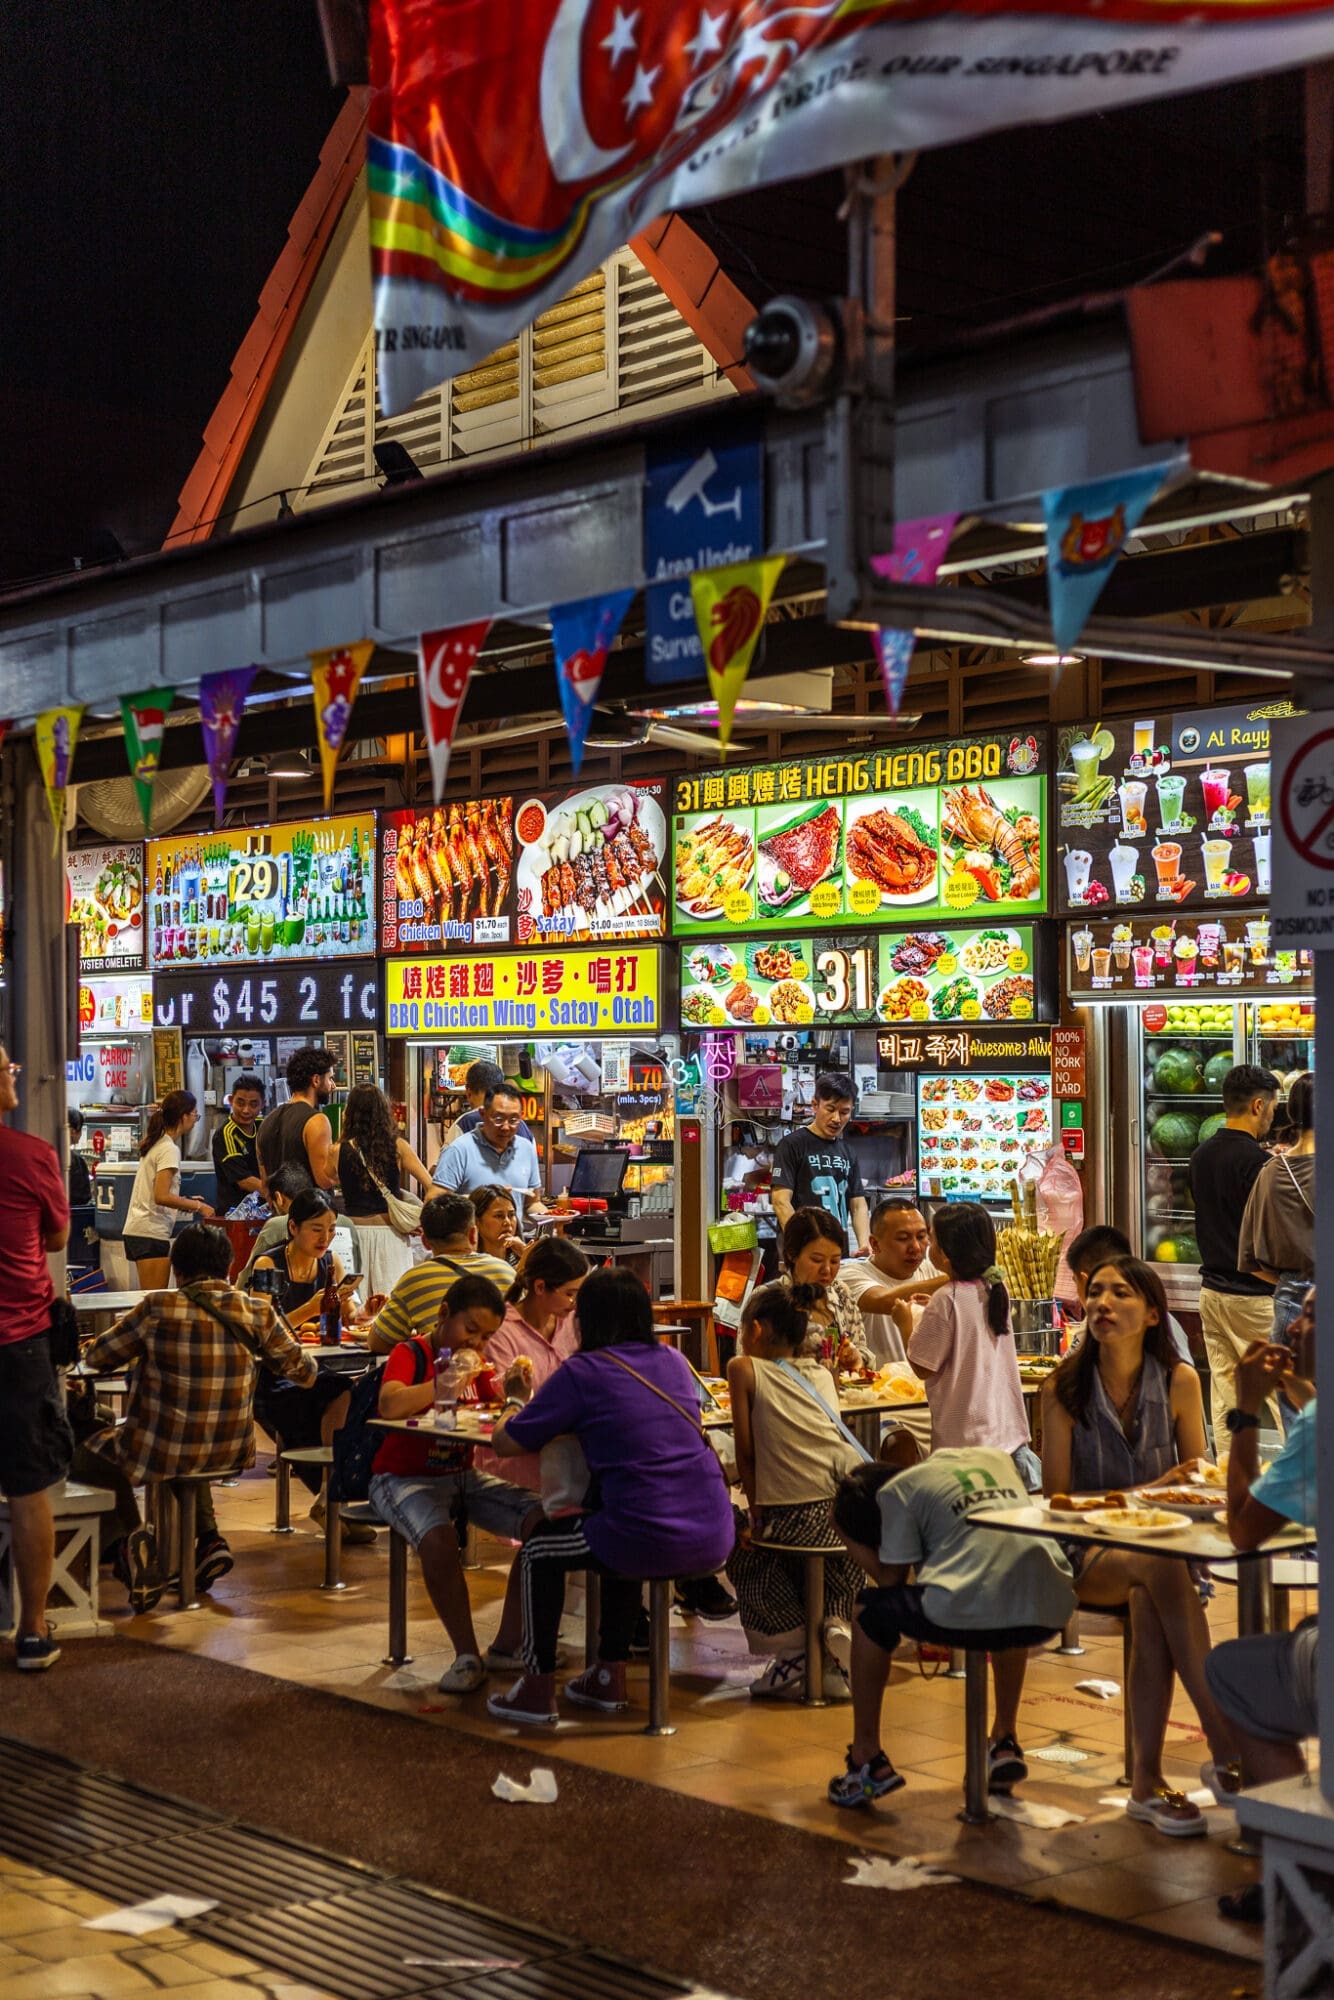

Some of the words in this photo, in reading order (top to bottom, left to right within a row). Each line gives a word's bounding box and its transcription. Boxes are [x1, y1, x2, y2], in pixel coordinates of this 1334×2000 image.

[655, 556, 695, 579] Area
[1206, 729, 1226, 748] Al
[677, 780, 700, 811] 31
[806, 760, 869, 797] HENG
[874, 751, 941, 788] HENG
[947, 743, 1000, 781] BBQ
[129, 847, 142, 865] 28
[235, 861, 273, 901] 29
[1306, 887, 1326, 907] NO
[399, 900, 423, 918] BBQ
[399, 923, 441, 941] Chicken
[442, 922, 472, 942] Wing
[475, 919, 497, 930] $1.70
[536, 914, 576, 936] Satay
[590, 919, 612, 930] $1.00
[105, 956, 142, 969] OMELETTE
[816, 948, 873, 1012] 31
[212, 977, 279, 1030] $45
[299, 976, 318, 1020] 2
[389, 1002, 419, 1031] BBQ
[423, 1001, 489, 1028] Chicken
[492, 999, 536, 1029] Wing
[549, 997, 599, 1027] Satay
[612, 995, 655, 1024] Otah
[1055, 1031, 1080, 1043] 100%
[99, 1047, 133, 1067] CARROT
[1055, 1045, 1070, 1057] NO
[1055, 1056, 1081, 1068] PORK
[104, 1070, 128, 1088] CAKE
[1055, 1071, 1071, 1083] NO
[1055, 1082, 1081, 1094] LARD
[617, 1093, 638, 1106] (min.
[640, 1093, 662, 1106] 3pcs)
[950, 1487, 1019, 1516] HAZZYS
